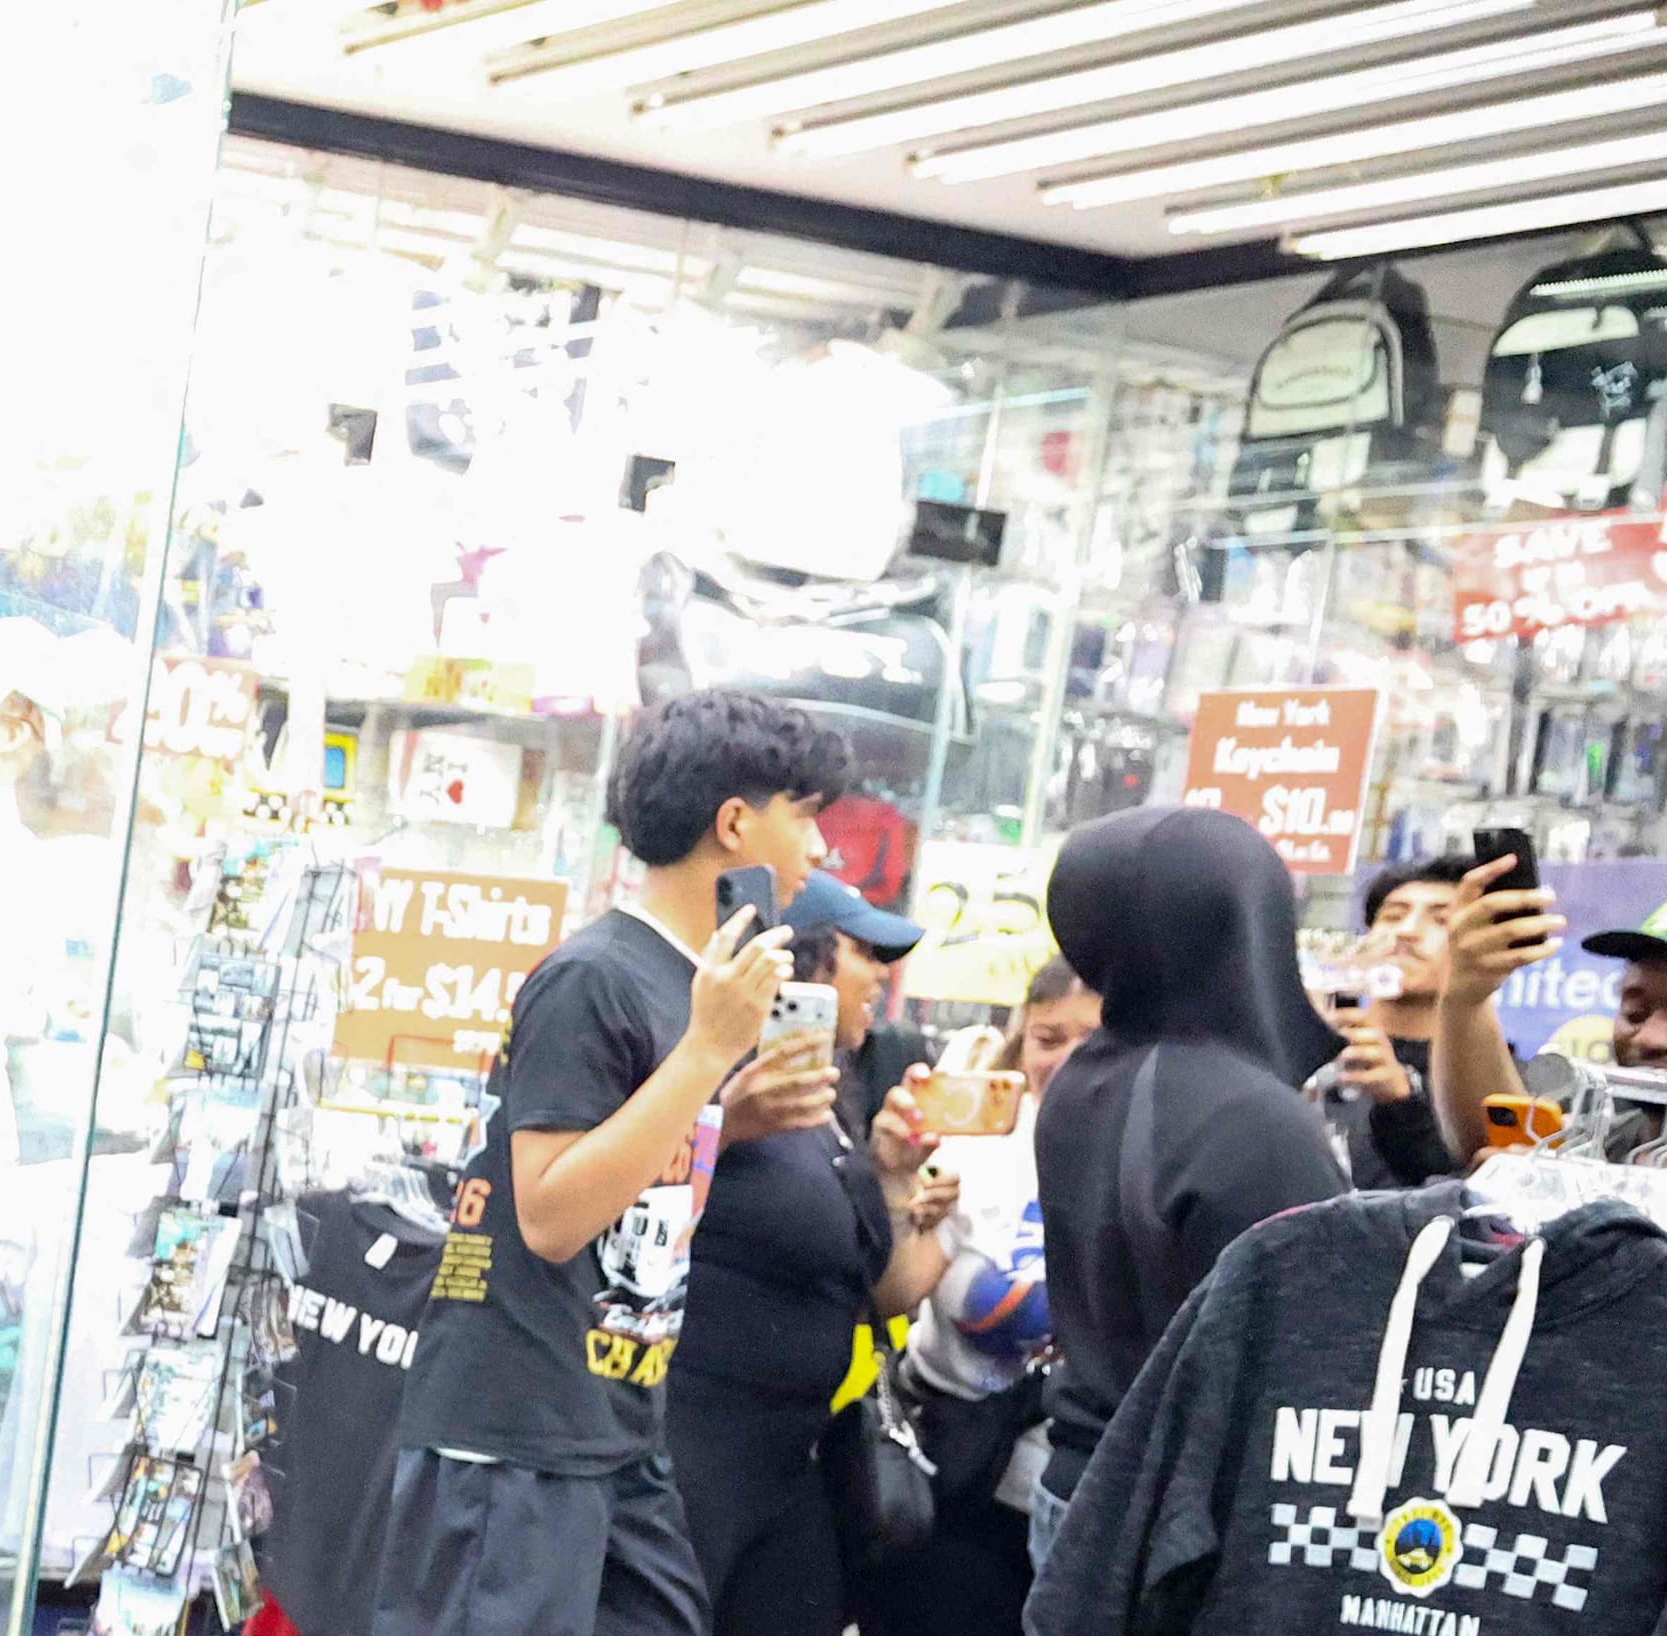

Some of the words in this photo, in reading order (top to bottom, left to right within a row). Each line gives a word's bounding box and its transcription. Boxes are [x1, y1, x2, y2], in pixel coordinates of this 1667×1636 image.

[420, 881, 553, 947] T-Shirts
[1493, 957, 1626, 1009] nite
[1413, 1367, 1476, 1405] USA
